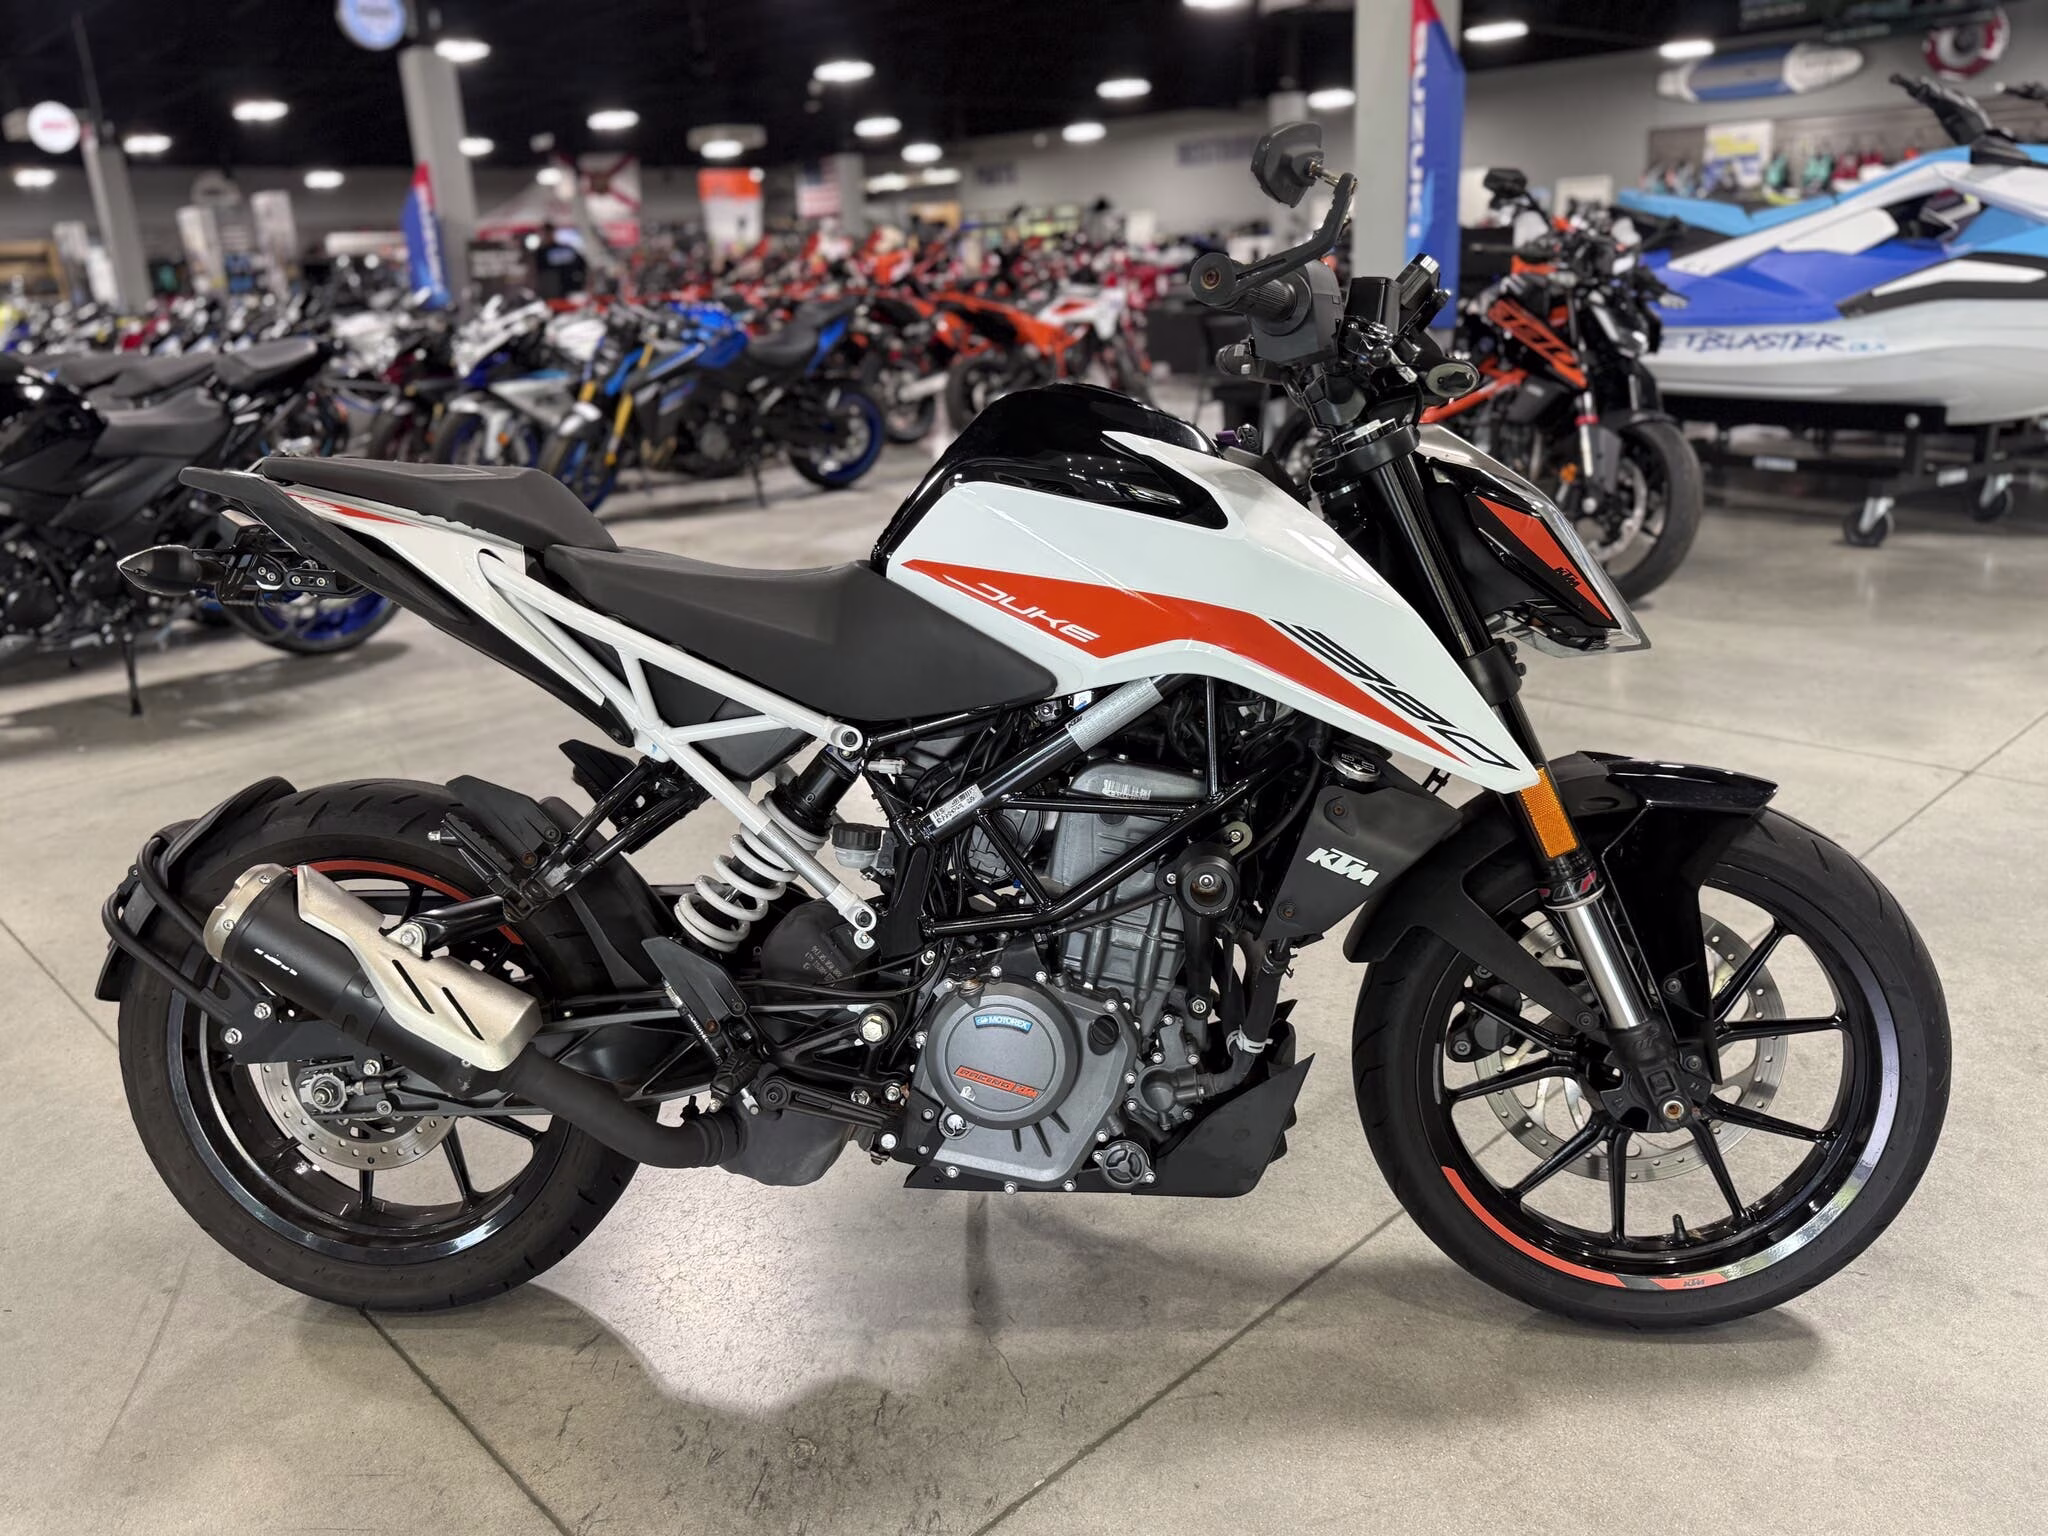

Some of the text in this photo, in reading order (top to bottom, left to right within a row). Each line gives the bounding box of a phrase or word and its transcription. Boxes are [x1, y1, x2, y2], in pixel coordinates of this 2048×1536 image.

[942, 573, 1102, 643] DUKE
[1268, 618, 1522, 772] 390
[1305, 847, 1380, 887] KTM
